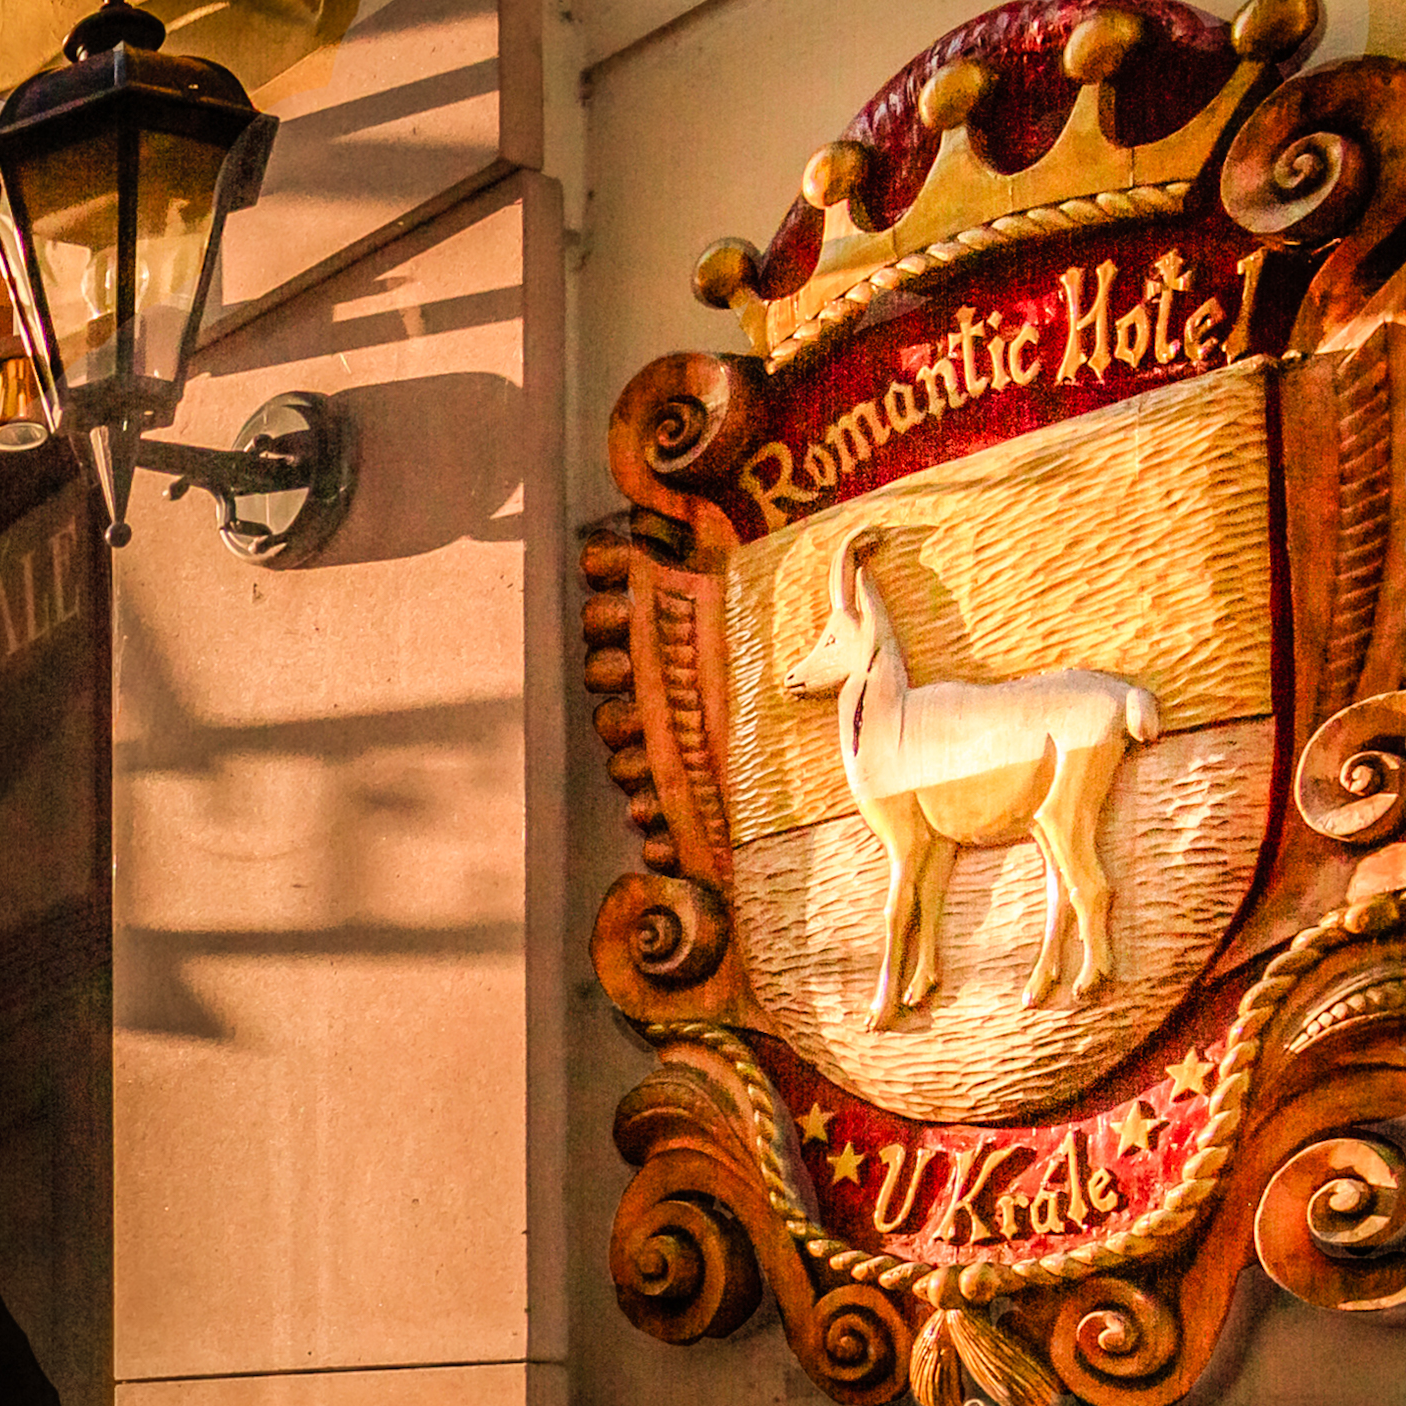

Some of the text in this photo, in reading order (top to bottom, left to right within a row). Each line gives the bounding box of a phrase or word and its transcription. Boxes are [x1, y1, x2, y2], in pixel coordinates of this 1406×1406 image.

[738, 246, 1269, 533] Romantic Hotel
[874, 1144, 936, 1233] U
